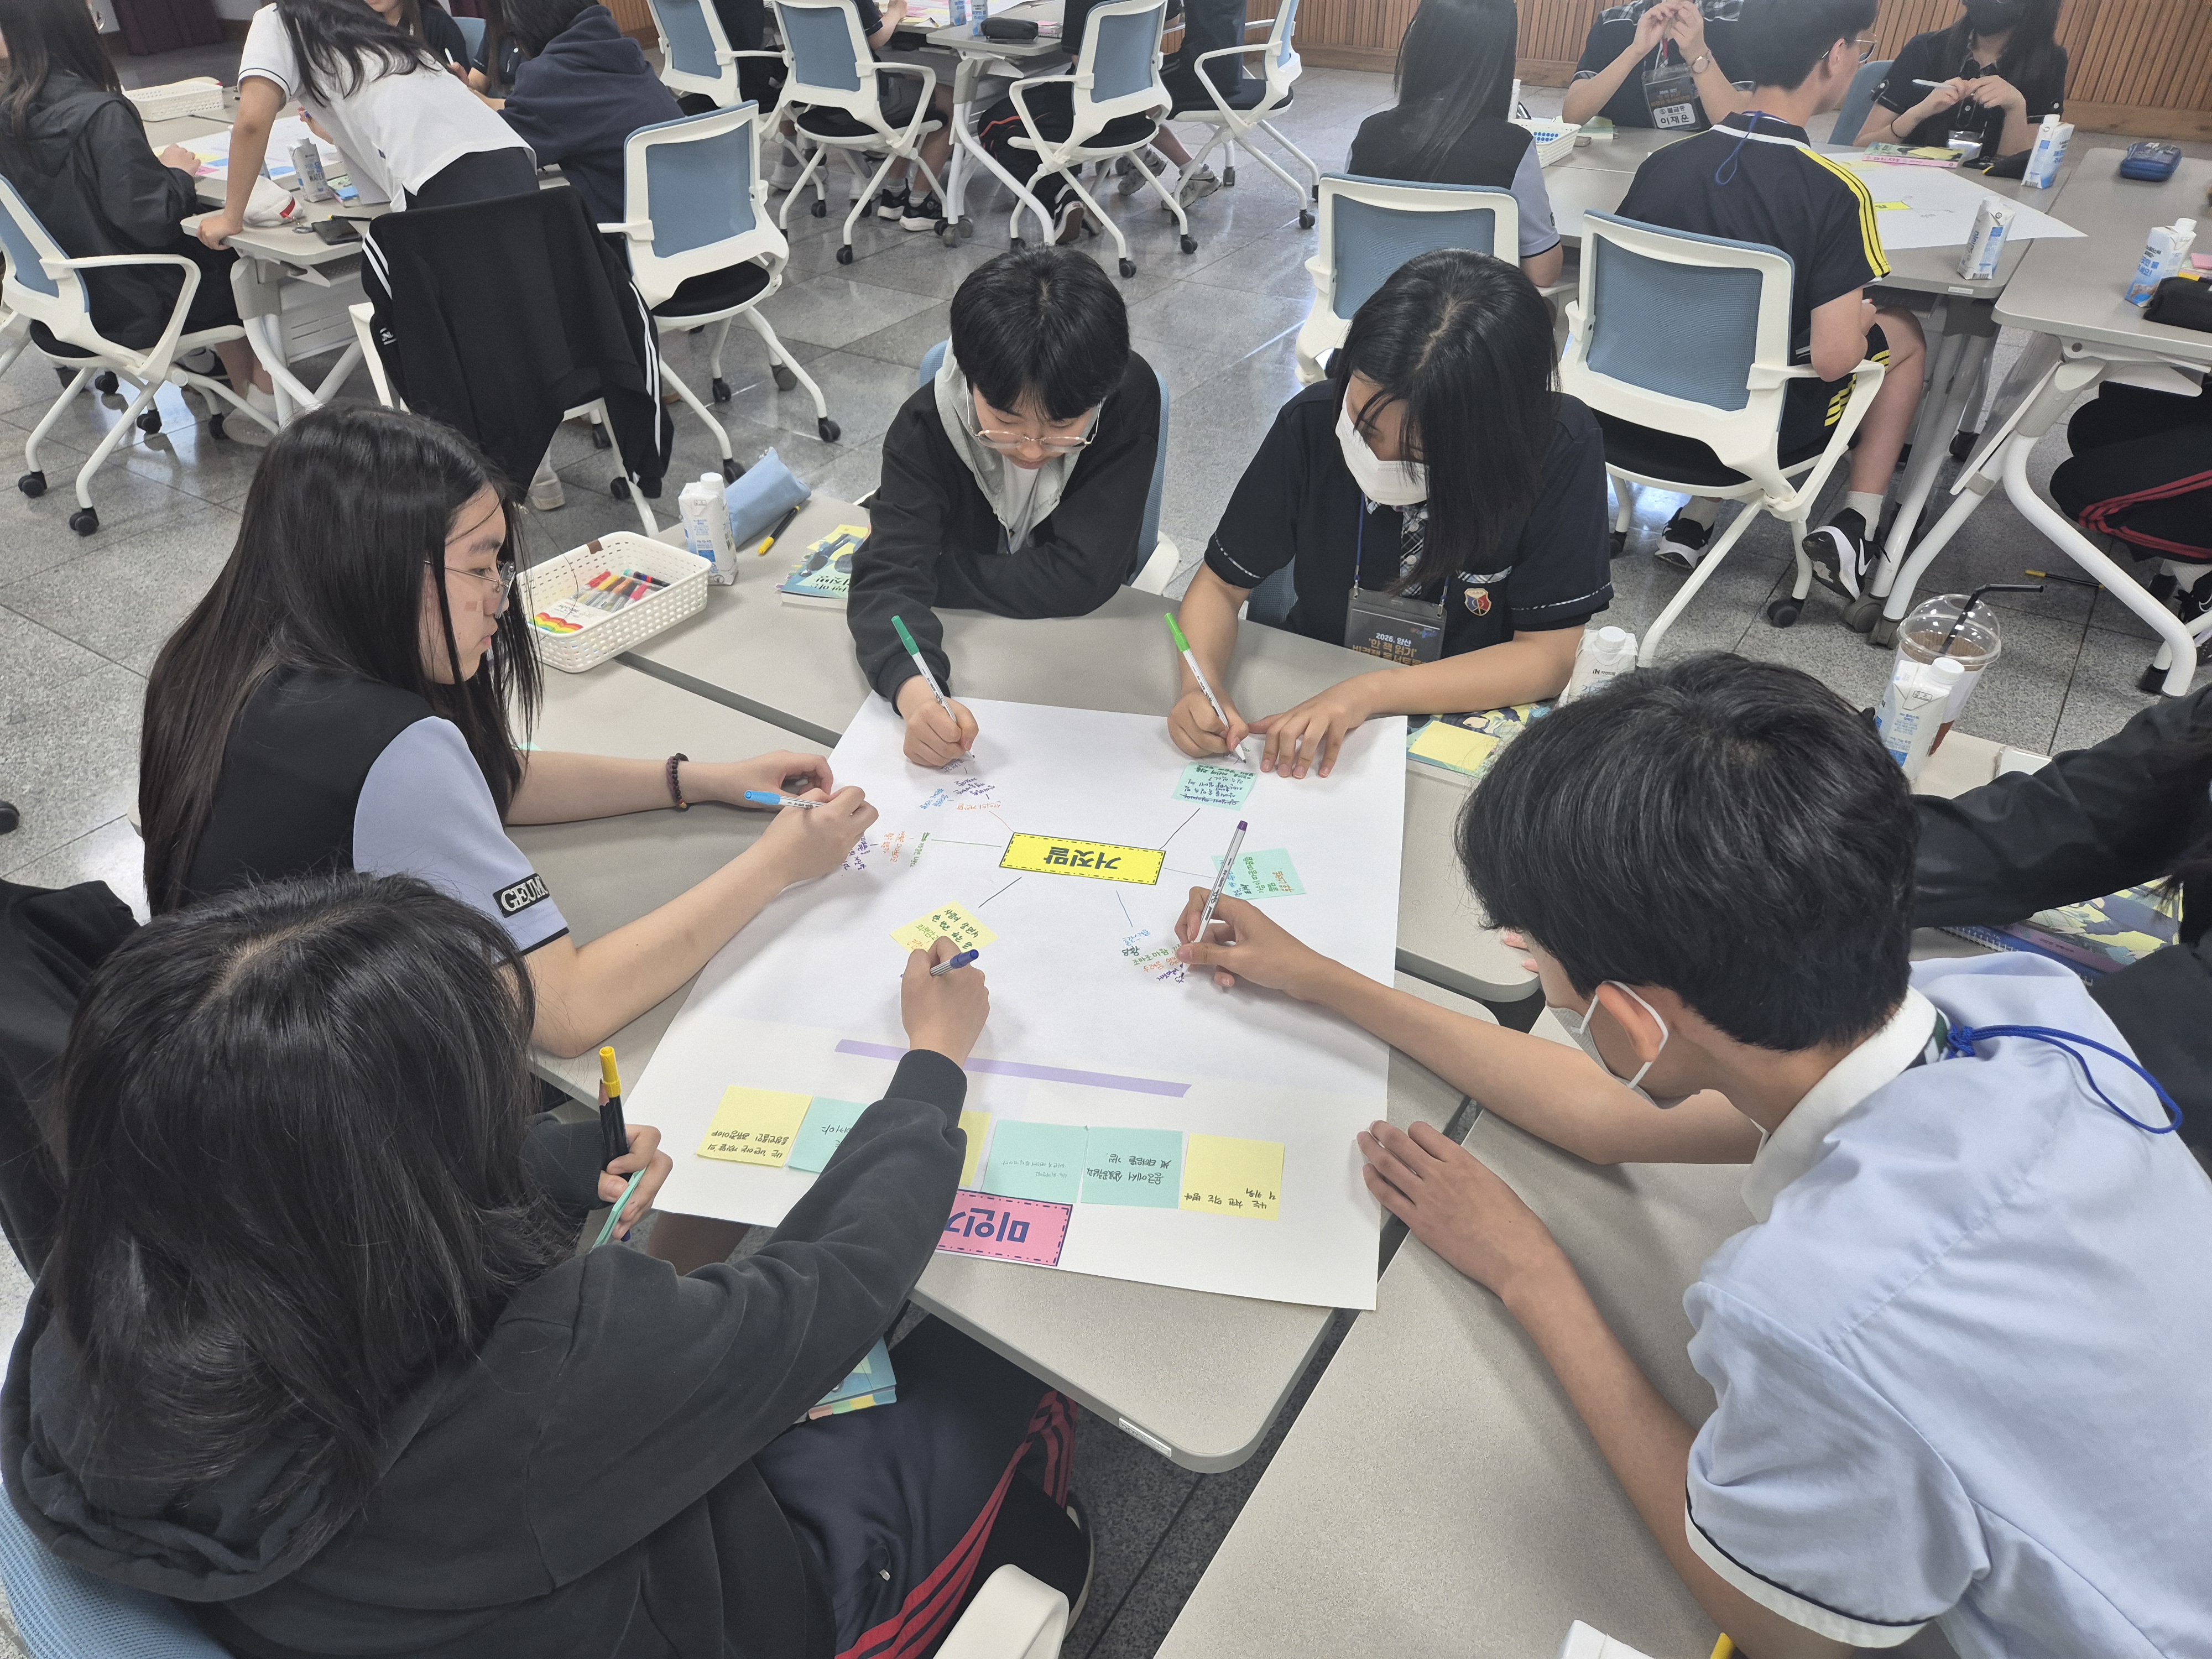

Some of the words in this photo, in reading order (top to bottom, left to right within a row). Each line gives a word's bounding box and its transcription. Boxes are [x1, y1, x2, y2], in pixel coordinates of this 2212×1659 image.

[979, 801, 1001, 810] 선의의
[1044, 847, 1121, 870] 거짓말
[771, 1150, 782, 1159] 나는
[1128, 1172, 1164, 1185] 용궁에서
[1184, 1193, 1201, 1202] 병아
[1208, 1194, 1222, 1205] 먹는
[1269, 1191, 1276, 1201] 리
[1228, 1198, 1243, 1209] 치킨
[1252, 1201, 1267, 1209] 나는
